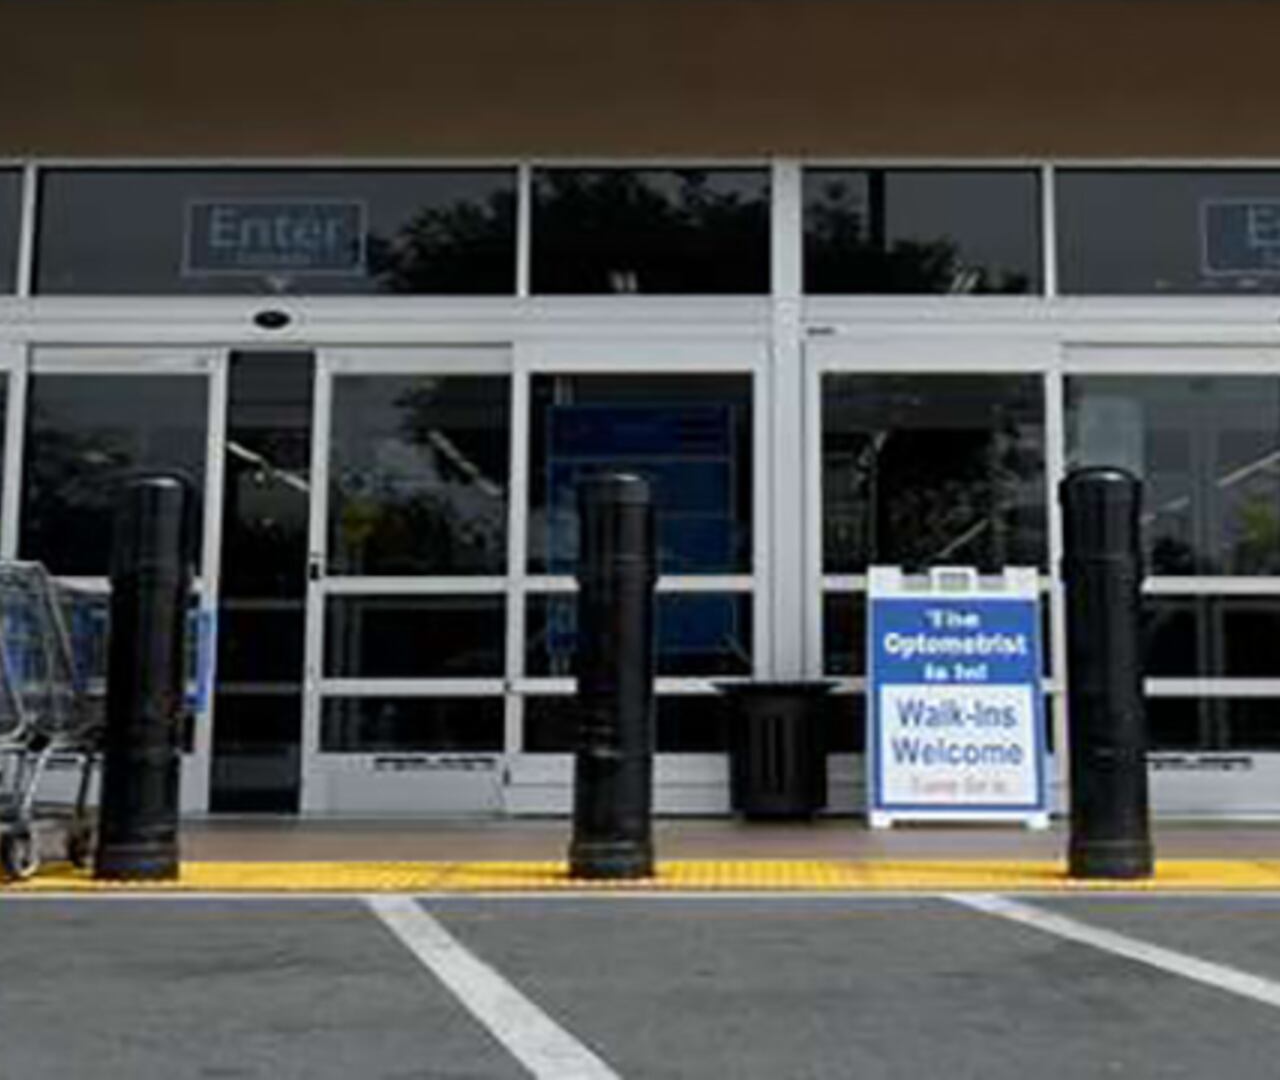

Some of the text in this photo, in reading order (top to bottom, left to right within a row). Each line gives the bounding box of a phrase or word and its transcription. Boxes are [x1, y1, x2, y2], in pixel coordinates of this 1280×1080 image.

[208, 205, 342, 248] Enter
[924, 608, 980, 629] The
[883, 632, 1028, 660] Optometrist
[896, 697, 1017, 728] Walk-Ins
[890, 737, 1024, 766] Welcome
